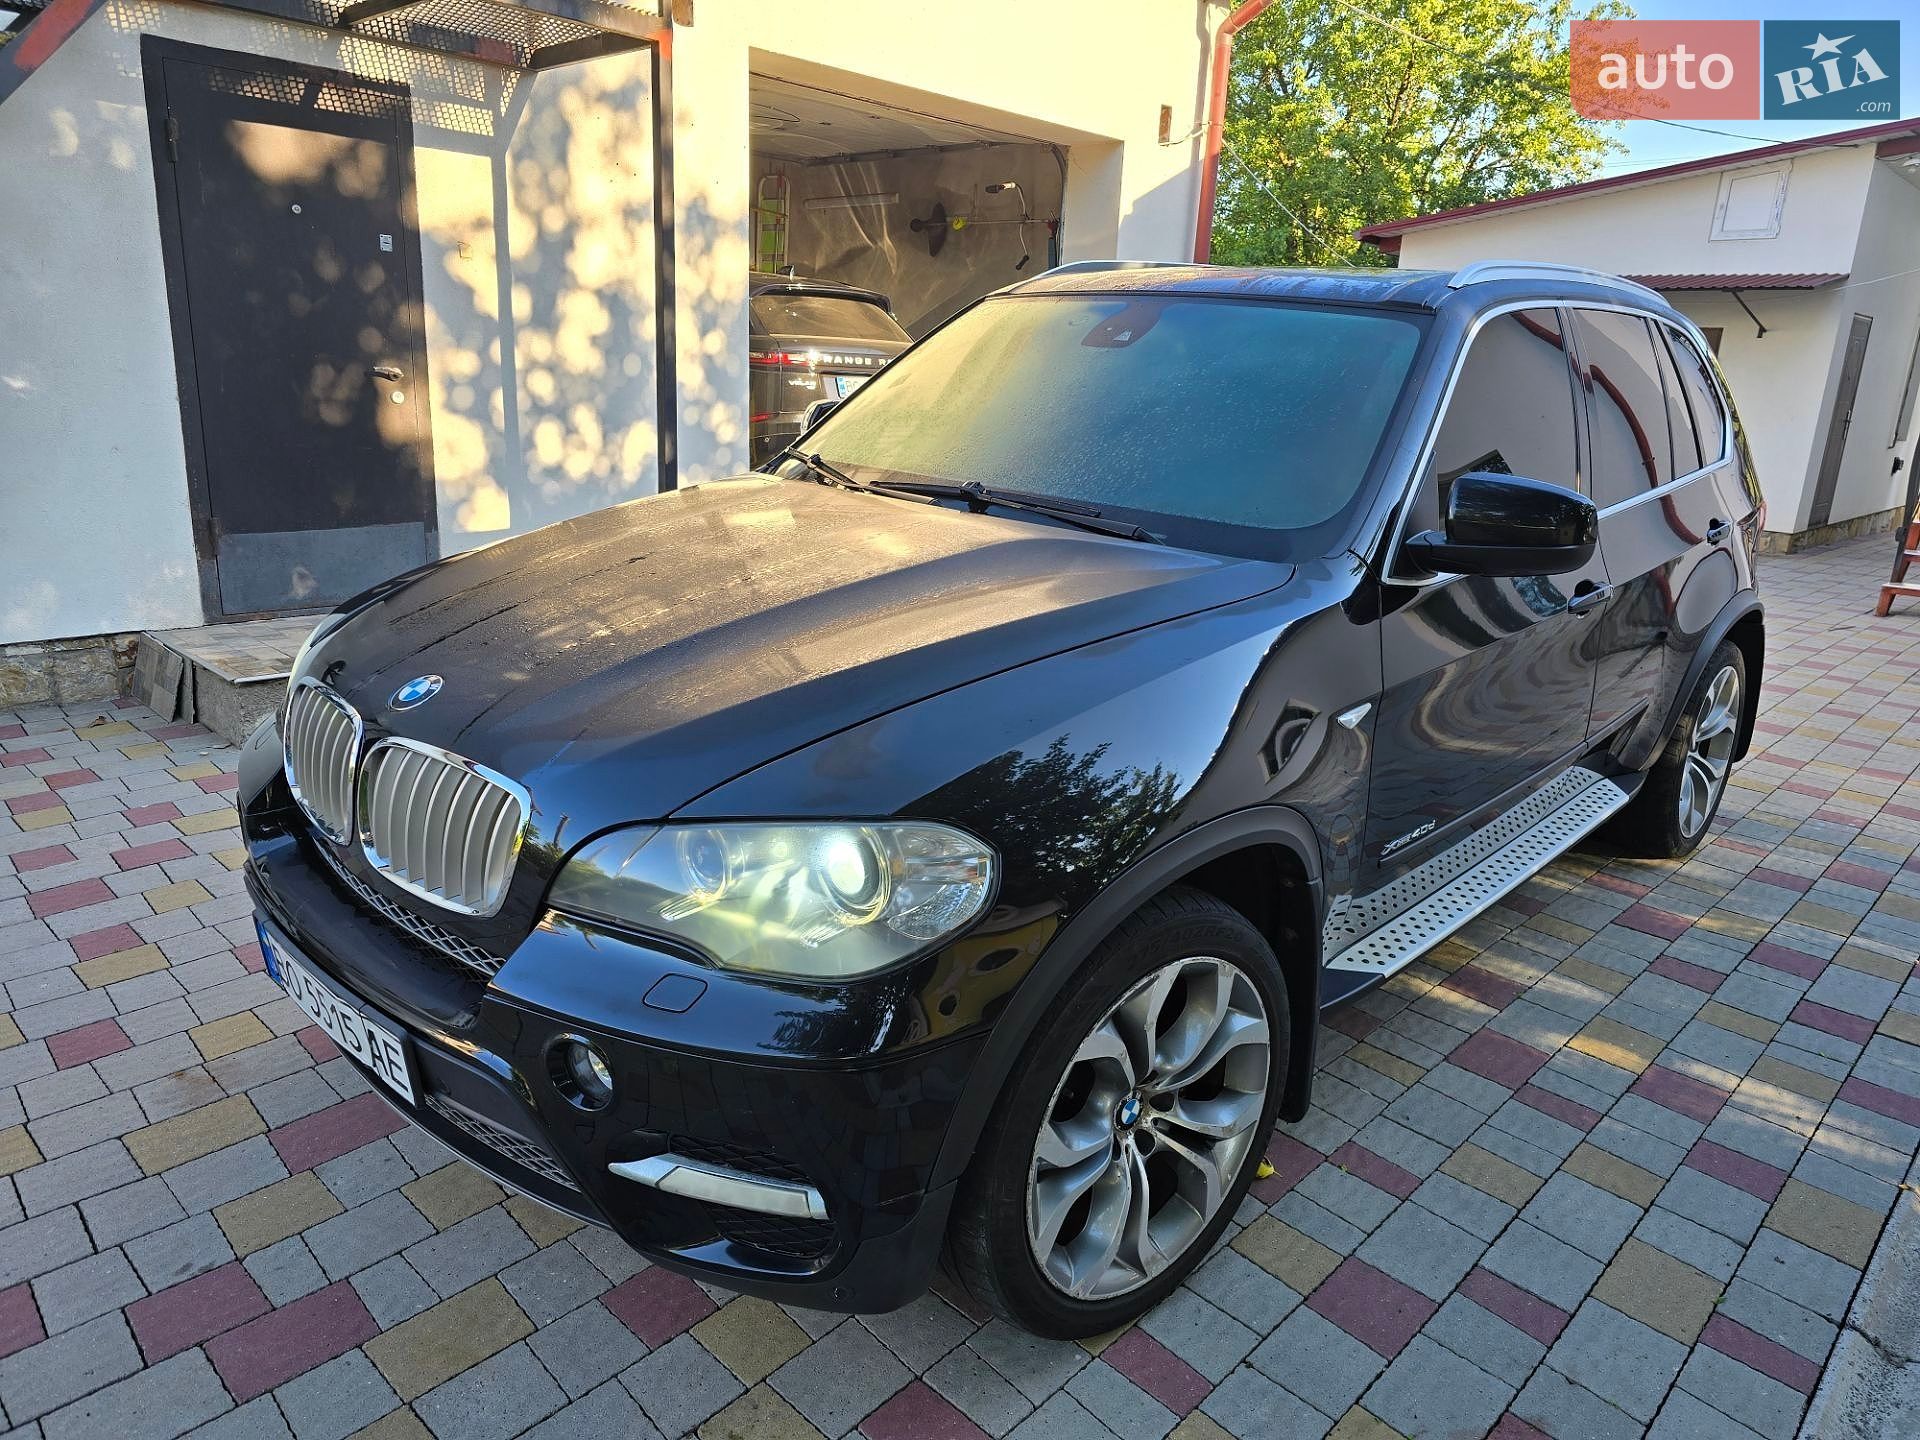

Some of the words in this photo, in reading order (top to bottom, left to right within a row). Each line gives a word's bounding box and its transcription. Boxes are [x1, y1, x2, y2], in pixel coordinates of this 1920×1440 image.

[822, 355, 872, 366] RANGE
[303, 976, 362, 1053] 5515
[366, 1029, 409, 1093] AE
